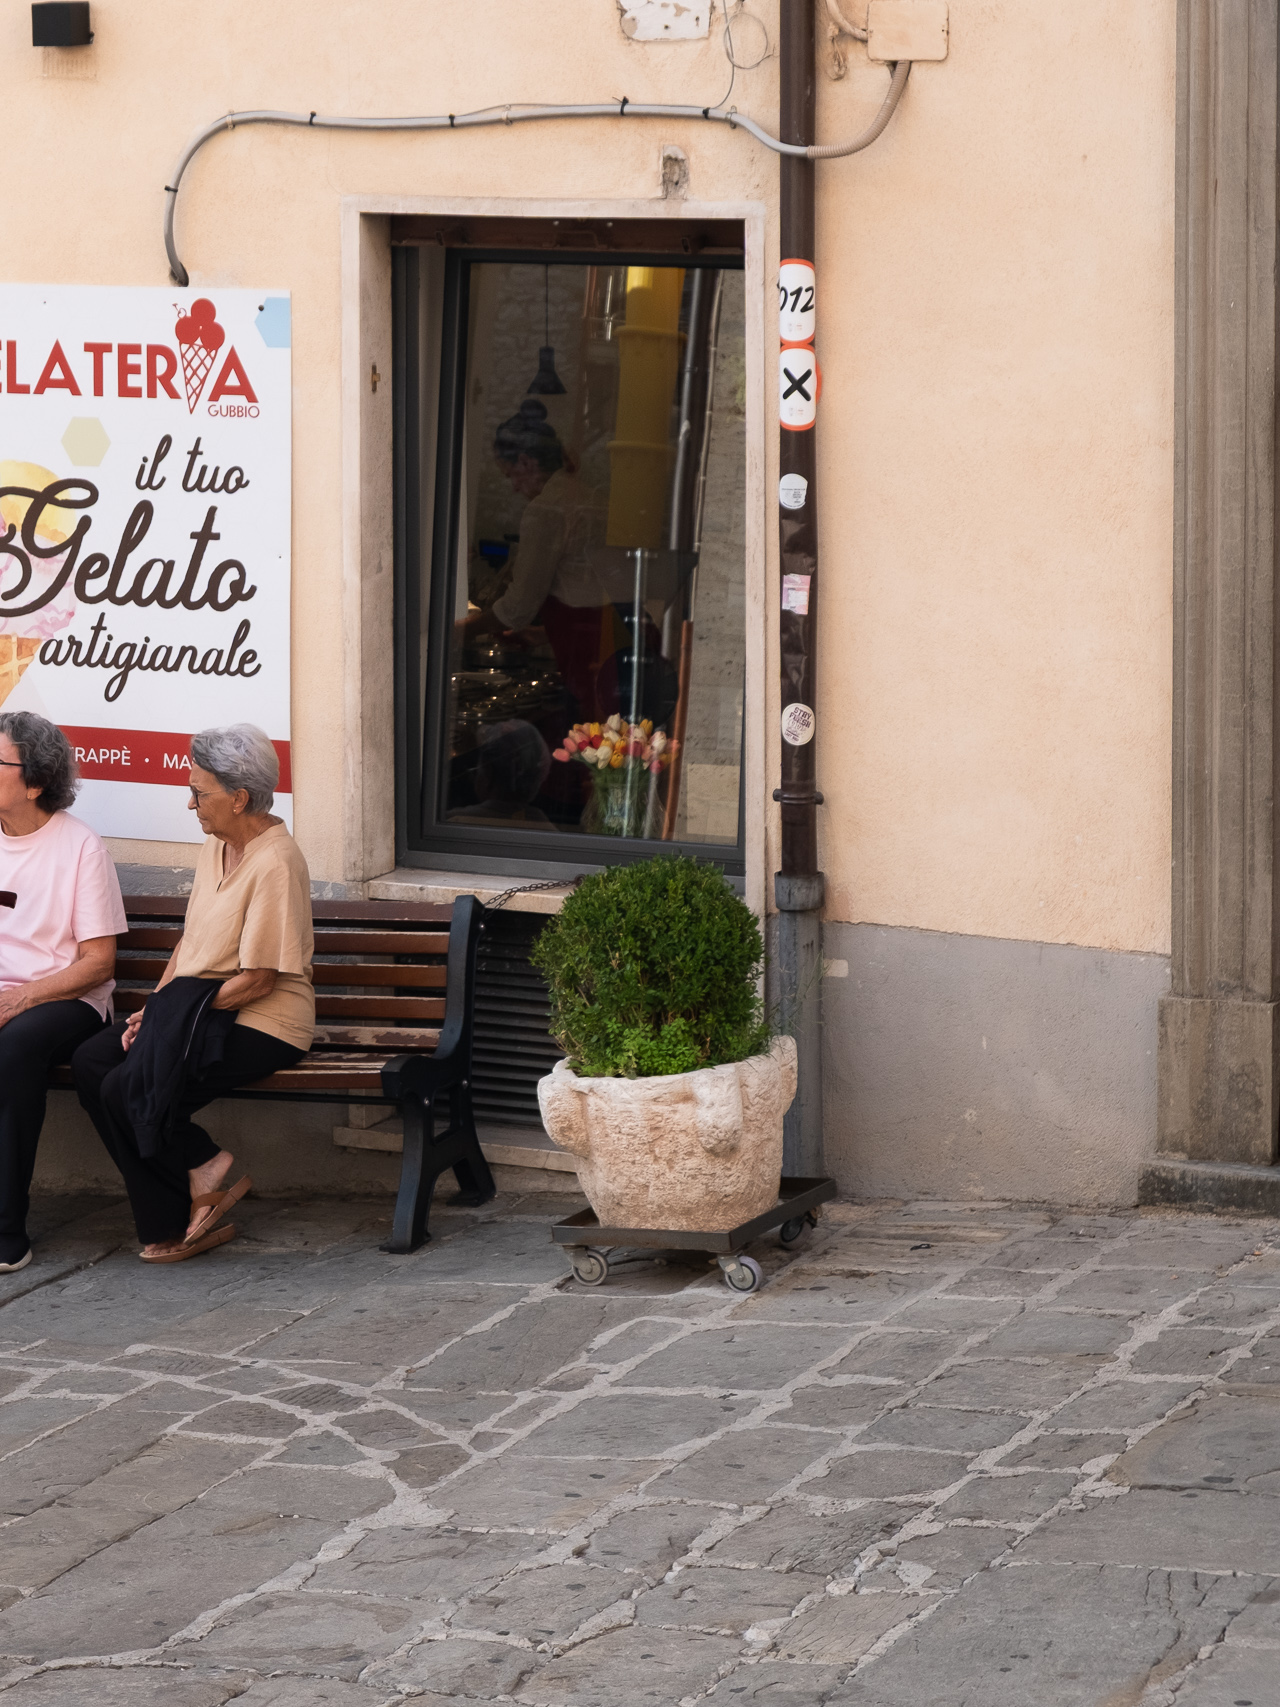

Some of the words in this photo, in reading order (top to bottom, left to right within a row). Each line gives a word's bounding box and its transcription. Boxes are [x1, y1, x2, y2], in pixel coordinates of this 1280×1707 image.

[207, 403, 260, 419] GUBBIO
[135, 433, 173, 491] il
[182, 436, 250, 494] tuo
[39, 611, 262, 702] artigianale
[71, 745, 131, 766] RAPPÈ
[163, 752, 192, 770] MA
